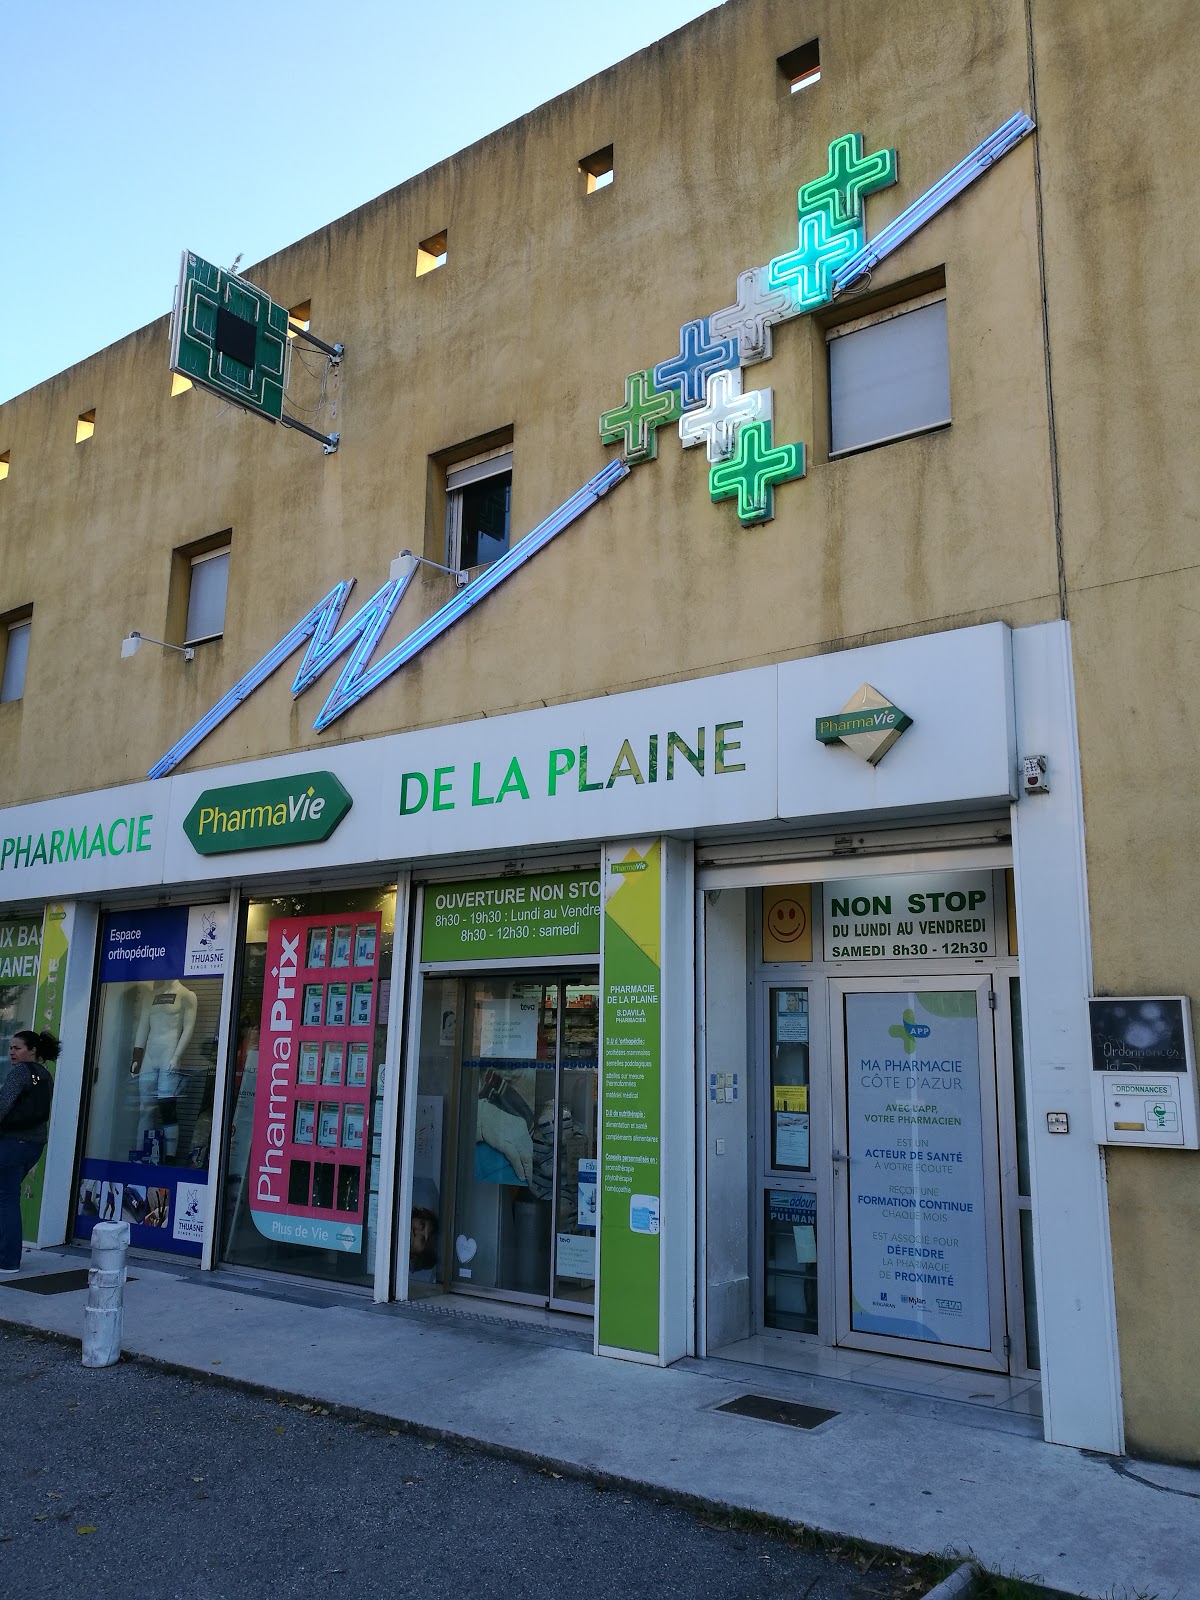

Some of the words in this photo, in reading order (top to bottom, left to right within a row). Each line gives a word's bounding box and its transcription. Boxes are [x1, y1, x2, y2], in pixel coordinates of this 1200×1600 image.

[820, 710, 895, 734] PharmaVie
[1, 814, 153, 871] PHARMACIE
[199, 786, 326, 836] PharmaVie
[399, 765, 455, 816] DE
[471, 756, 530, 807] LA
[547, 720, 746, 797] PLAINE
[435, 888, 526, 910] OUVERTURE
[530, 883, 564, 902] NON
[568, 880, 600, 899] STO
[831, 895, 892, 917] NON
[907, 890, 986, 913] STOP
[435, 913, 460, 927] 8h30
[470, 911, 502, 925] 19h30
[511, 907, 540, 922] Lundi
[544, 910, 557, 919] au
[560, 904, 600, 918] Vendre
[460, 929, 486, 942] 8h30
[498, 926, 529, 940] 12h30
[539, 922, 580, 937] samedi
[832, 924, 849, 938] DU
[854, 922, 891, 937] LUNDI
[896, 921, 914, 935] AU
[918, 918, 986, 934] VENDREDI
[110, 929, 141, 943] Espace
[108, 945, 166, 961] orthopédique
[831, 945, 885, 957] SAMEDI
[892, 943, 928, 956] 8h30
[942, 941, 988, 954] 12h30
[191, 953, 224, 963] THUASNE
[610, 984, 655, 993] PHARMACIE
[630, 995, 658, 1003] PLAINE
[520, 1003, 535, 1011] teva
[1103, 1041, 1179, 1057] Ordonnances
[861, 1060, 881, 1071] MA
[885, 1060, 962, 1073] PHARMACIE
[861, 1073, 900, 1089] CÔTE
[906, 1077, 963, 1090] D'AZUR
[1116, 1085, 1168, 1094] ORDONNANCES
[885, 1104, 910, 1113] AVEC
[865, 1114, 895, 1123] VOTRE
[898, 1116, 962, 1126] PHARMACIEN
[897, 1138, 913, 1147] EST
[915, 1139, 929, 1148] UN
[865, 1149, 907, 1160] ACTEUR
[910, 1151, 923, 1160] DE
[927, 1151, 963, 1163] SANTÉ
[884, 1162, 913, 1172] VOTRE
[889, 1185, 918, 1196] REÇOIT
[920, 1187, 940, 1197] UNE
[857, 1195, 916, 1208] FORMATION
[919, 1199, 974, 1213] CONTINUE
[770, 1212, 815, 1224] PULMAN
[882, 1209, 920, 1220] CHAQUE
[923, 1212, 948, 1222] MOIS
[179, 1222, 204, 1233] THUASNE
[272, 1221, 292, 1236] Plus
[295, 1225, 308, 1238] de
[311, 1227, 329, 1241] Vie
[872, 1231, 888, 1241] EST
[891, 1233, 930, 1245] ASSOCIÉ
[933, 1237, 959, 1247] POUR
[887, 1245, 944, 1259] DÉFENDRE
[882, 1258, 894, 1267] LA
[896, 1259, 950, 1273] PHARMACIE
[879, 1270, 892, 1280] DE
[894, 1271, 954, 1287] PROXIMITÉ
